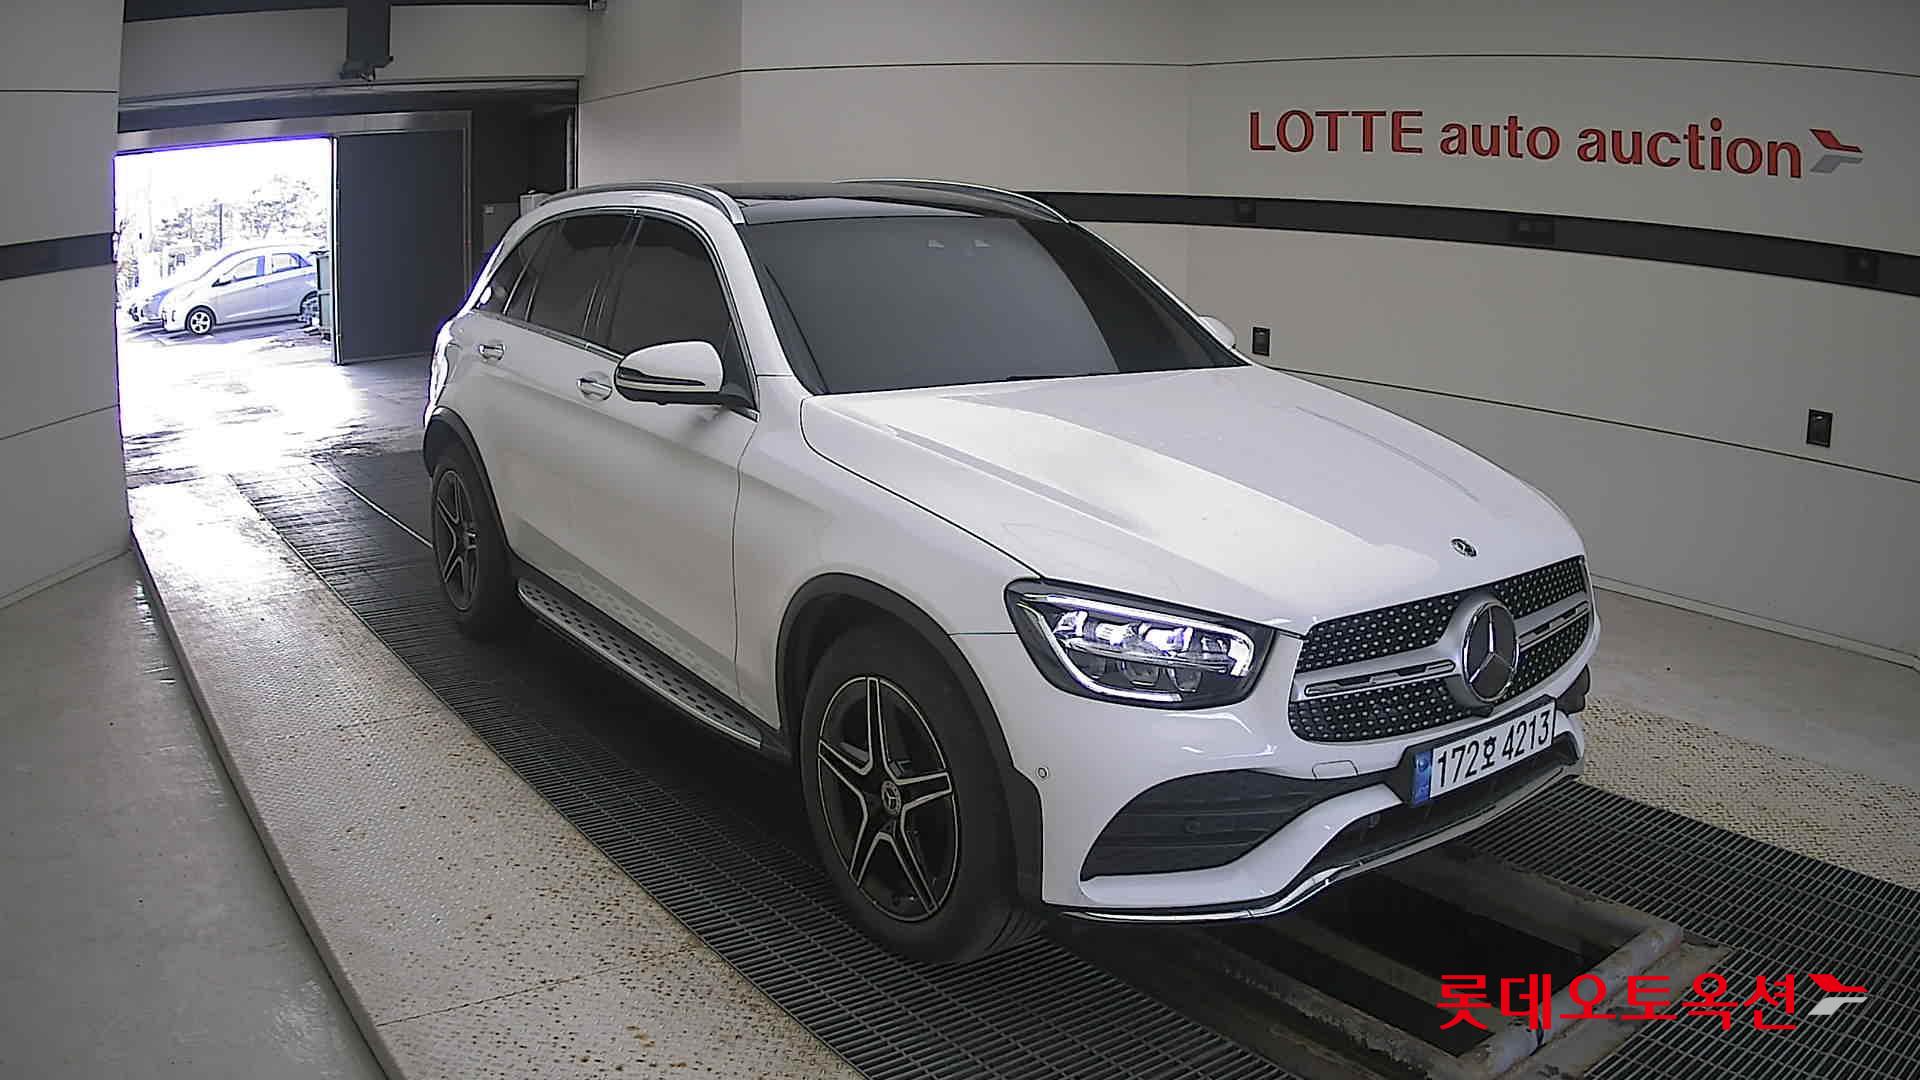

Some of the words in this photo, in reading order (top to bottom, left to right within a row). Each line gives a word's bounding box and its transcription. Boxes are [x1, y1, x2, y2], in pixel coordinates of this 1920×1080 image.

[1249, 110, 1423, 154] LOTTE
[1439, 115, 1561, 160] auto
[1577, 117, 1802, 178] auction
[1502, 709, 1551, 760] 4213
